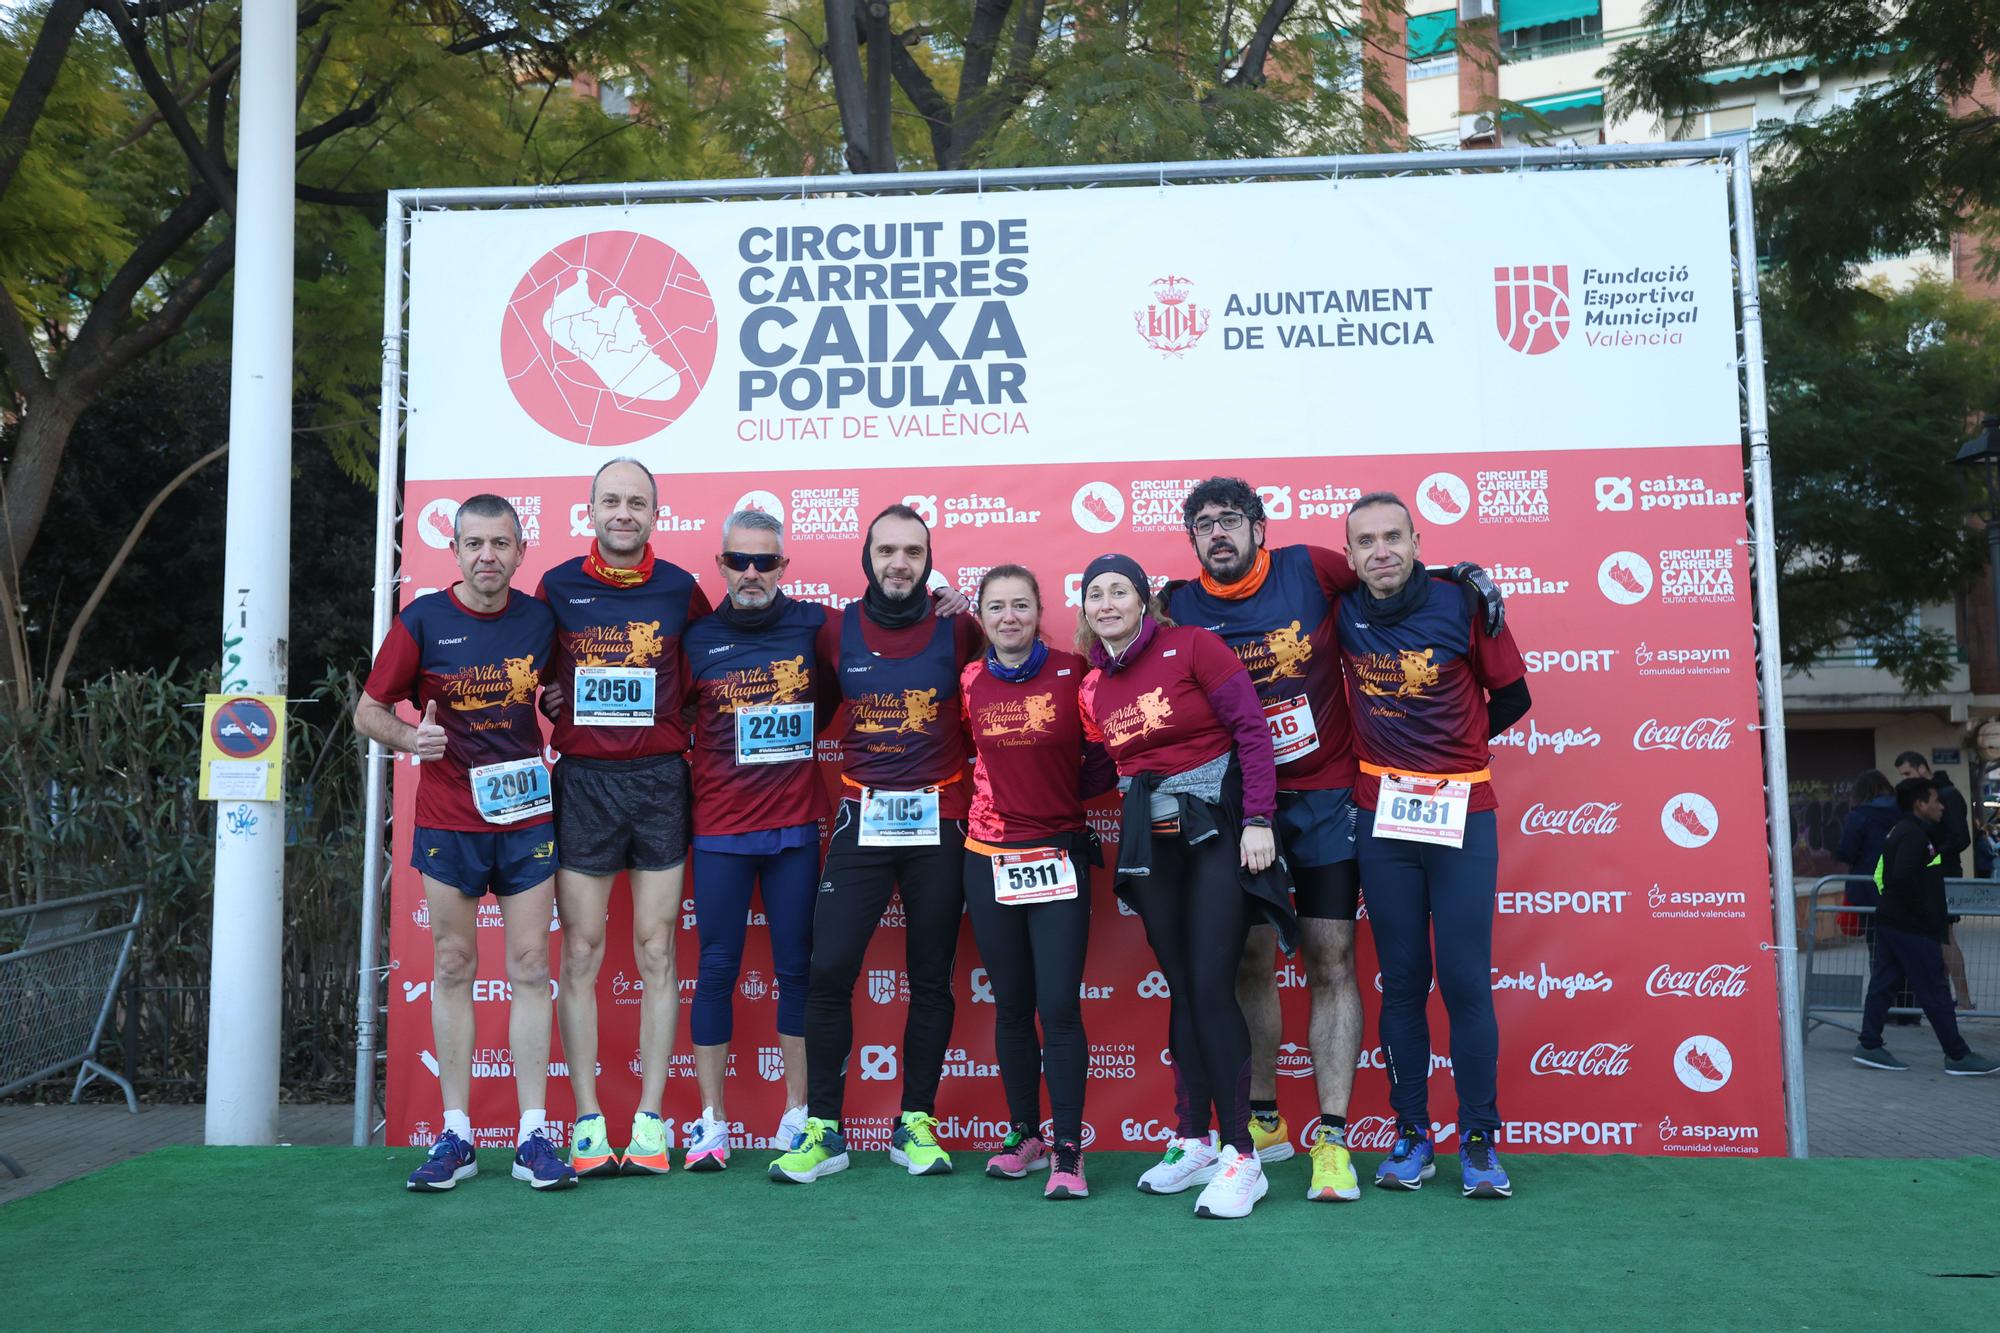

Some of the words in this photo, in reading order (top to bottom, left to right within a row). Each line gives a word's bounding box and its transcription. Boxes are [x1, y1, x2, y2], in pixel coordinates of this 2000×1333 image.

[739, 222, 943, 263] CIRCUIT
[961, 219, 1029, 255] DE
[739, 258, 1029, 304] CARRERES
[1583, 265, 1689, 285] Fundació
[1224, 287, 1433, 317] AJUNTAMENT
[1584, 286, 1694, 309] Esportiva
[1585, 306, 1698, 329] Municipal
[739, 301, 1028, 367] CAIXA
[1224, 326, 1265, 350] DE
[1277, 317, 1434, 348] VALÈNCIA
[1585, 329, 1682, 347] València
[739, 363, 1028, 411] POPULAR
[737, 417, 834, 441] CIUTAT
[843, 416, 879, 438] DE
[888, 408, 1030, 437] VALÈNCIA
[1476, 470, 1527, 480] CIRCUIT
[1530, 469, 1549, 480] DE
[1131, 480, 1181, 490] CIRCUIT
[1476, 479, 1549, 491] CARRERES
[1640, 475, 1705, 492] caixa
[525, 496, 541, 505] DE
[791, 488, 840, 499] CIRCUIT
[842, 488, 860, 498] DE
[1131, 488, 1192, 500] CARRERE
[1298, 484, 1362, 501] caixa
[1478, 489, 1549, 506] CAIXA
[1640, 488, 1743, 511] popular
[791, 497, 860, 509] CARRERES
[944, 493, 1007, 510] caixa
[1132, 499, 1184, 515] CAIX
[1478, 503, 1549, 517] POPULAR
[656, 515, 706, 531] ular
[791, 507, 859, 523] CAIXA
[944, 507, 1041, 528] popular
[1132, 513, 1185, 526] POPUL
[791, 521, 860, 534] POPULAR
[1659, 549, 1711, 560] CIRCUIT
[1715, 548, 1733, 559] DE
[1660, 558, 1733, 570] CARRERES
[1661, 568, 1734, 585] CAIXA
[773, 580, 831, 596] aixa
[1495, 577, 1569, 598] pular
[1662, 584, 1735, 596] POPULAR
[597, 625, 624, 642] Vila
[1234, 640, 1264, 660] Vila
[1657, 648, 1731, 664] aspaym
[1371, 653, 1397, 671] Vila
[1523, 650, 1615, 673] SPORT
[474, 664, 503, 681] Vila
[739, 666, 769, 684] Vila
[1639, 666, 1686, 676] comunidad
[1687, 665, 1731, 675] valenciana
[584, 678, 642, 703] 2050
[873, 692, 901, 709] Vila
[1000, 700, 1023, 713] Vila
[1118, 703, 1138, 720] Vila
[748, 714, 802, 740] 2249
[1633, 717, 1736, 751] Coca-Cola
[487, 767, 538, 801] 2001
[872, 797, 923, 822] 2105
[1391, 796, 1451, 825] 6831
[1520, 802, 1623, 835] Coca-Cola
[1007, 862, 1059, 890] 5311
[1495, 890, 1624, 914] ERSPORT
[1670, 890, 1746, 906] aspaym
[1652, 910, 1699, 918] comunidad
[1701, 910, 1746, 918] valenciana
[1646, 963, 1752, 998] Coca-Cola
[1090, 1043, 1135, 1053] DACIÓN
[1088, 1054, 1136, 1067] NIDAD
[1530, 1043, 1634, 1077] Coca-Cola
[471, 1063, 511, 1078] UDAD
[1086, 1067, 1136, 1079] FONSO
[844, 1117, 894, 1125] FUNDACI
[936, 1115, 1012, 1139] divino
[844, 1127, 893, 1140] TRINID
[1681, 1123, 1759, 1139] aspaym
[1663, 1143, 1711, 1153] comunidad
[1714, 1145, 1759, 1154] valenciana
